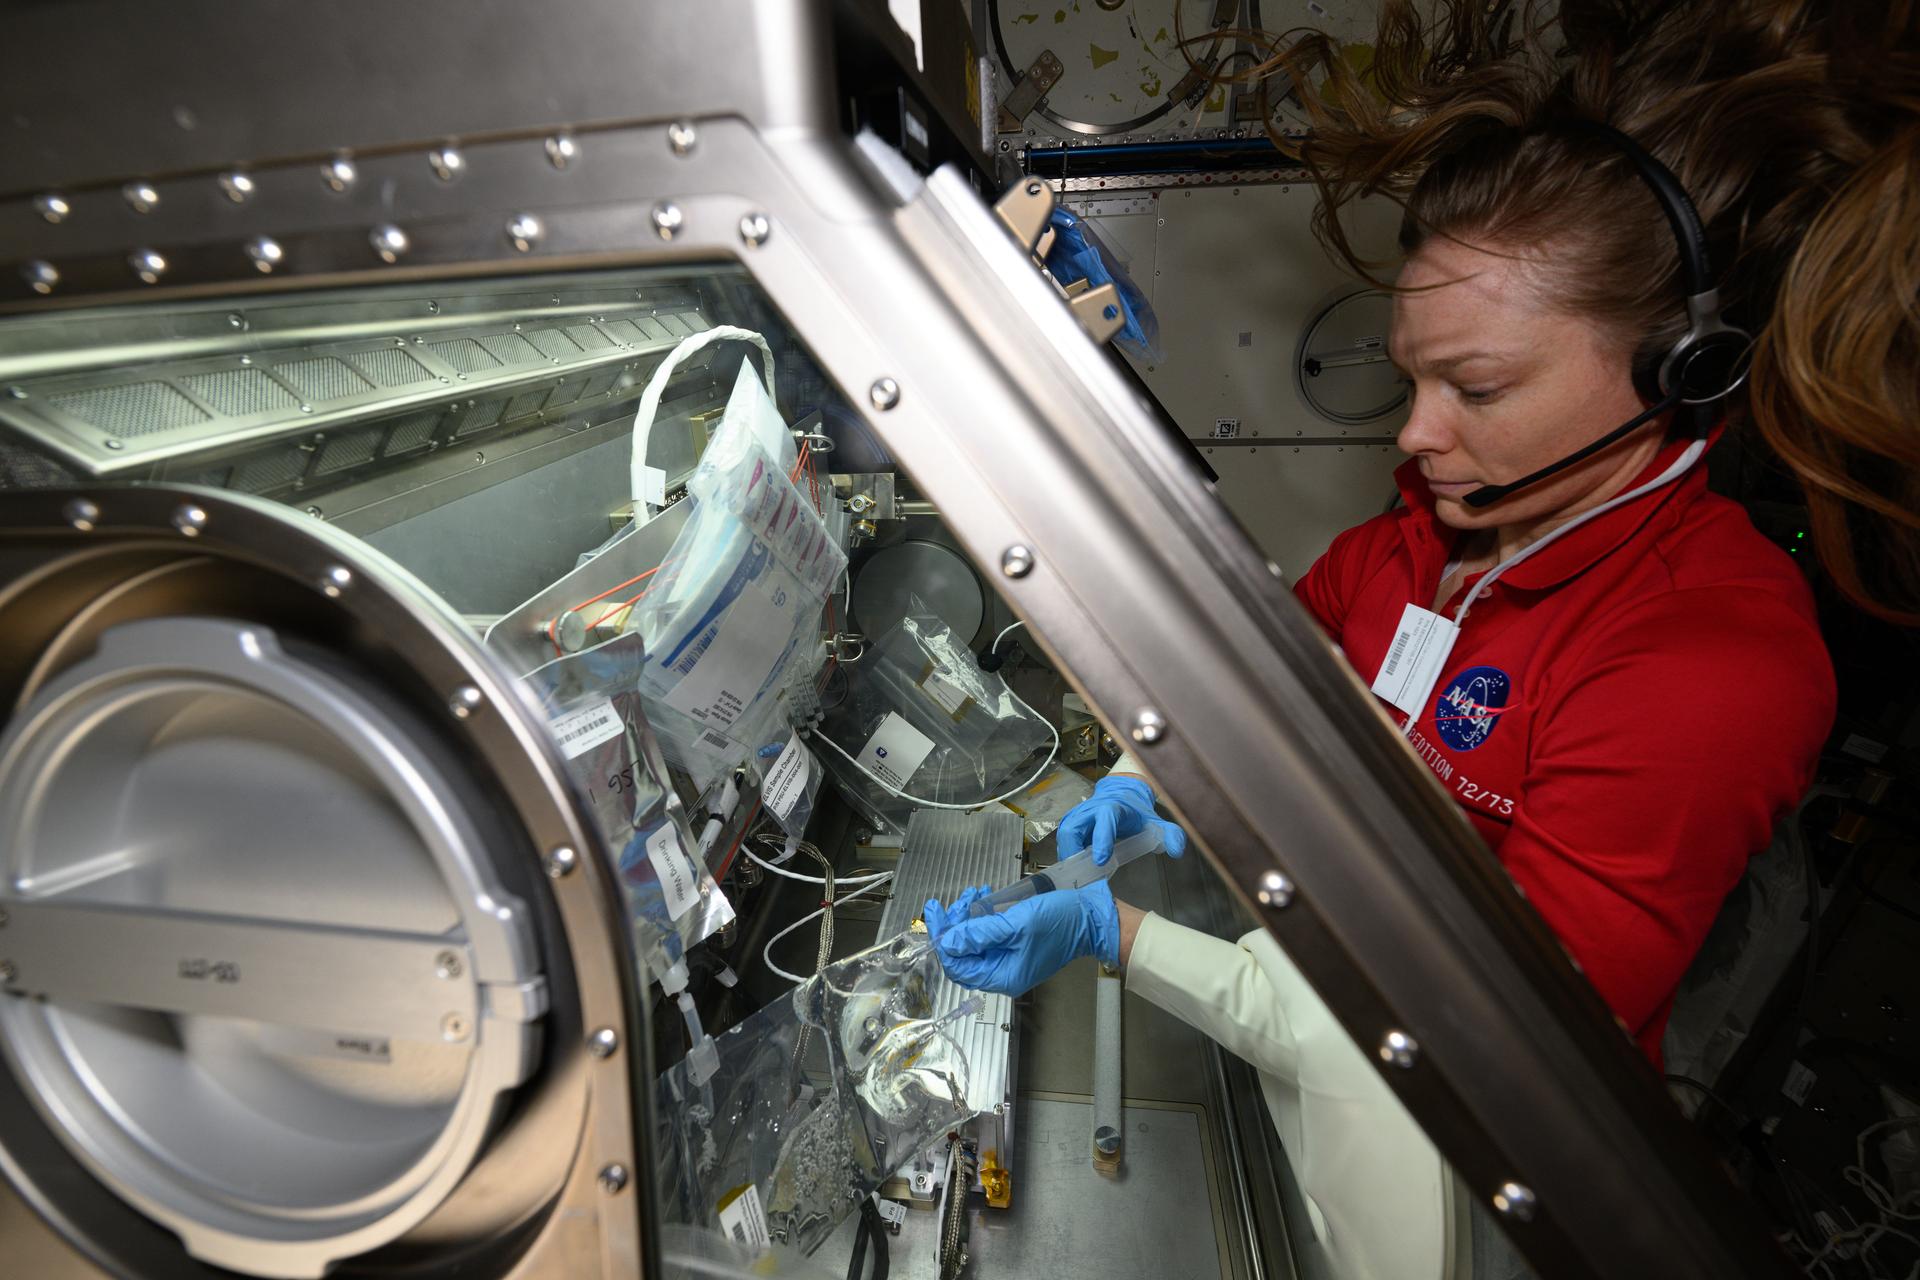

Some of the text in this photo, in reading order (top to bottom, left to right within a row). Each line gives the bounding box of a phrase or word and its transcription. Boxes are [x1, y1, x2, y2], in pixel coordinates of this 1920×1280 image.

[1446, 685, 1493, 735] NASA
[762, 748, 797, 802] ELVIS Sample Chamber
[1400, 718, 1514, 815] EPEDITION 72/73
[659, 839, 685, 902] Drinking Water
